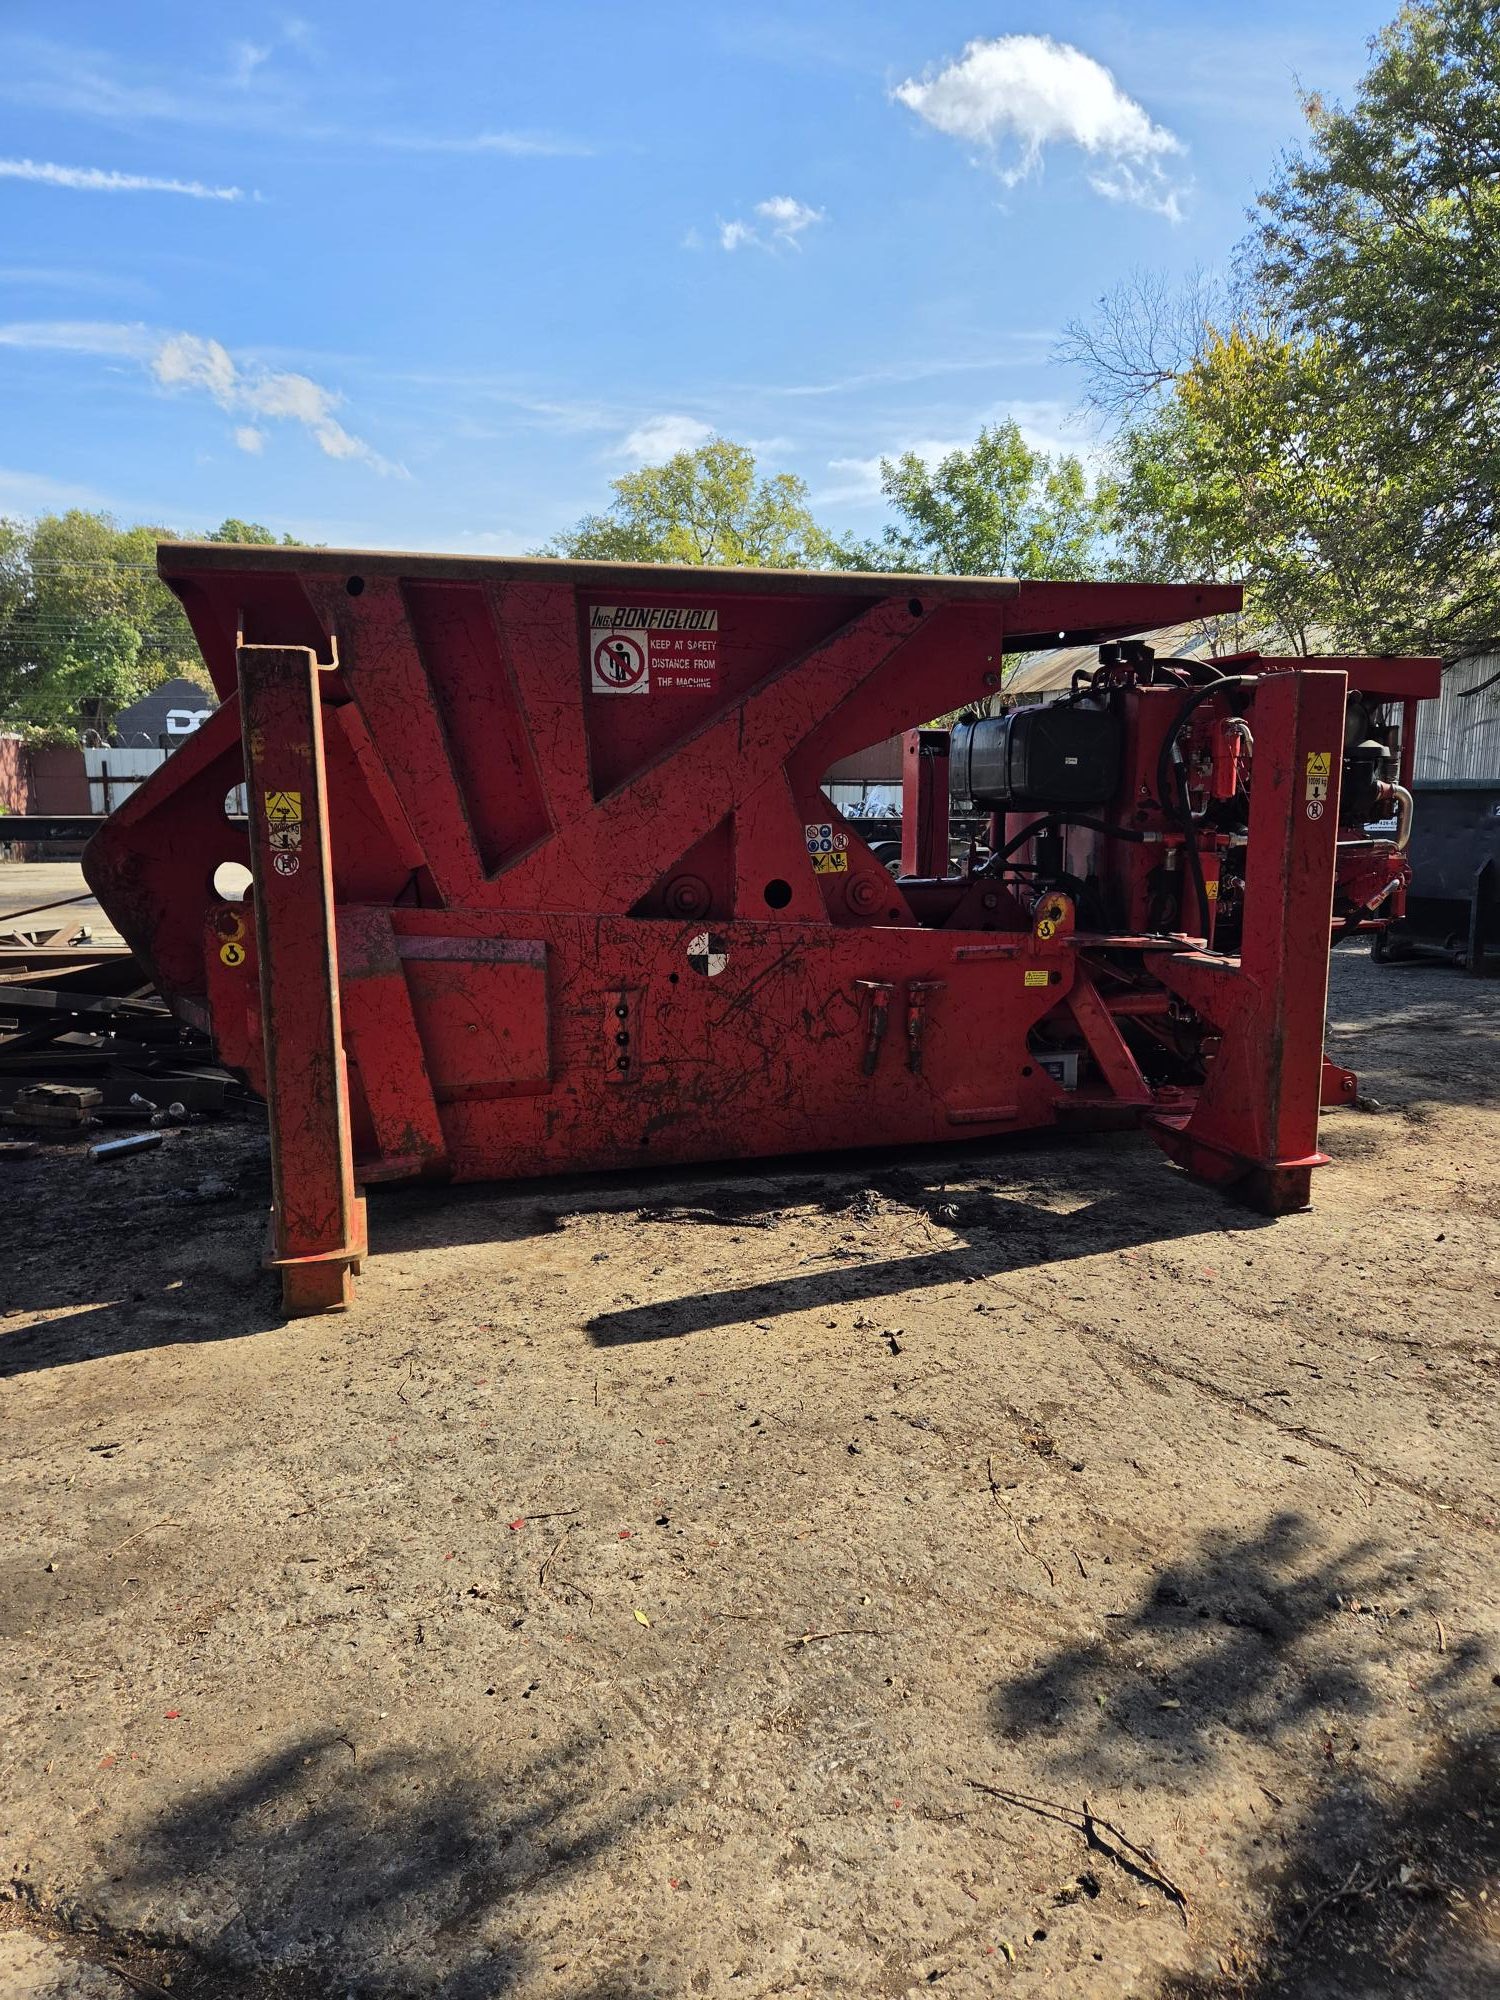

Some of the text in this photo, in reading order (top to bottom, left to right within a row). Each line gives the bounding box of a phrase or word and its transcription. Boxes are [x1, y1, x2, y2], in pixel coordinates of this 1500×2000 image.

[650, 639, 717, 651] KEEP AT SAFETY
[651, 658, 716, 669] DISTANCE FROM
[657, 677, 712, 689] THE MACHINE
